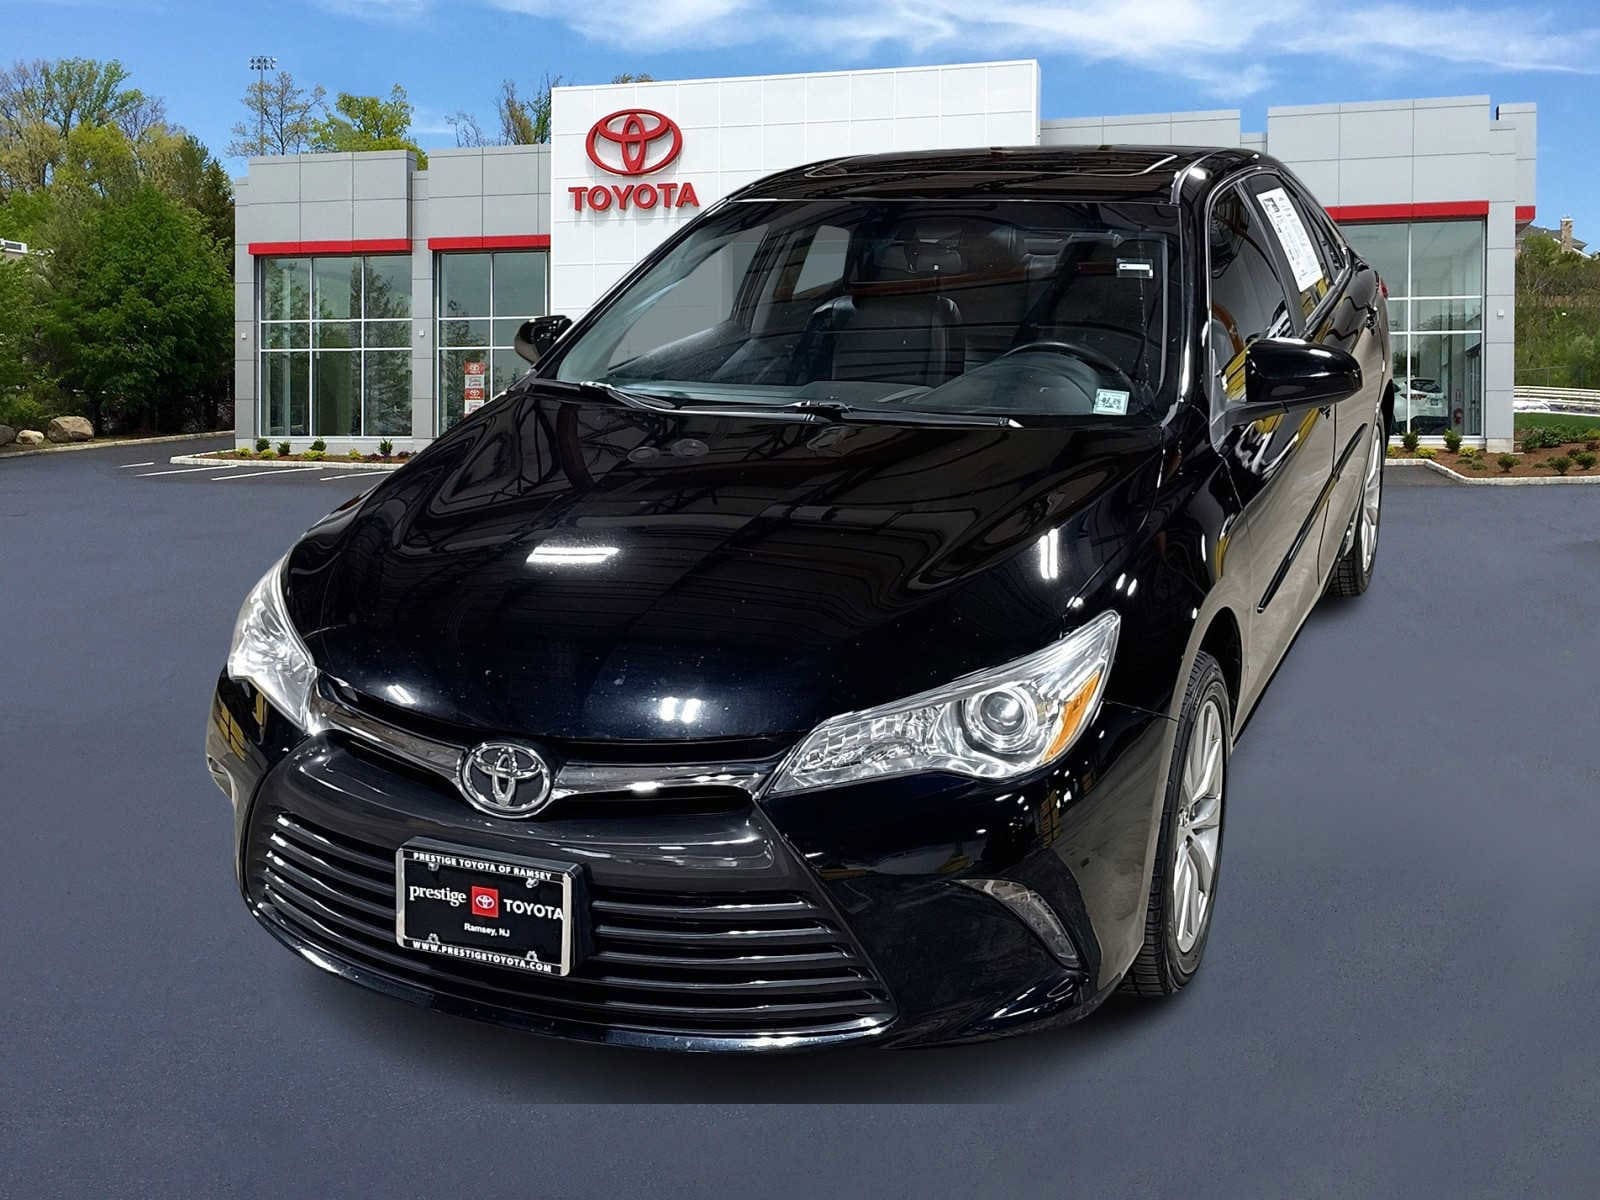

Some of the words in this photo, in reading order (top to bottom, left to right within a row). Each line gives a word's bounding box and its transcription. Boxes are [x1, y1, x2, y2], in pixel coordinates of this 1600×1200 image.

[568, 182, 700, 211] TOYOTA
[413, 852, 457, 866] PRESTIGE
[459, 861, 496, 873] TOYOTA
[498, 866, 511, 875] OF
[513, 868, 552, 880] RAMSEY
[409, 885, 467, 907] prestige
[503, 898, 564, 920] TOYOTA
[464, 922, 498, 937] Ramsey,
[498, 926, 510, 937] NJ
[412, 941, 552, 973] WWW.PRESTIGETOYOTA.COM
